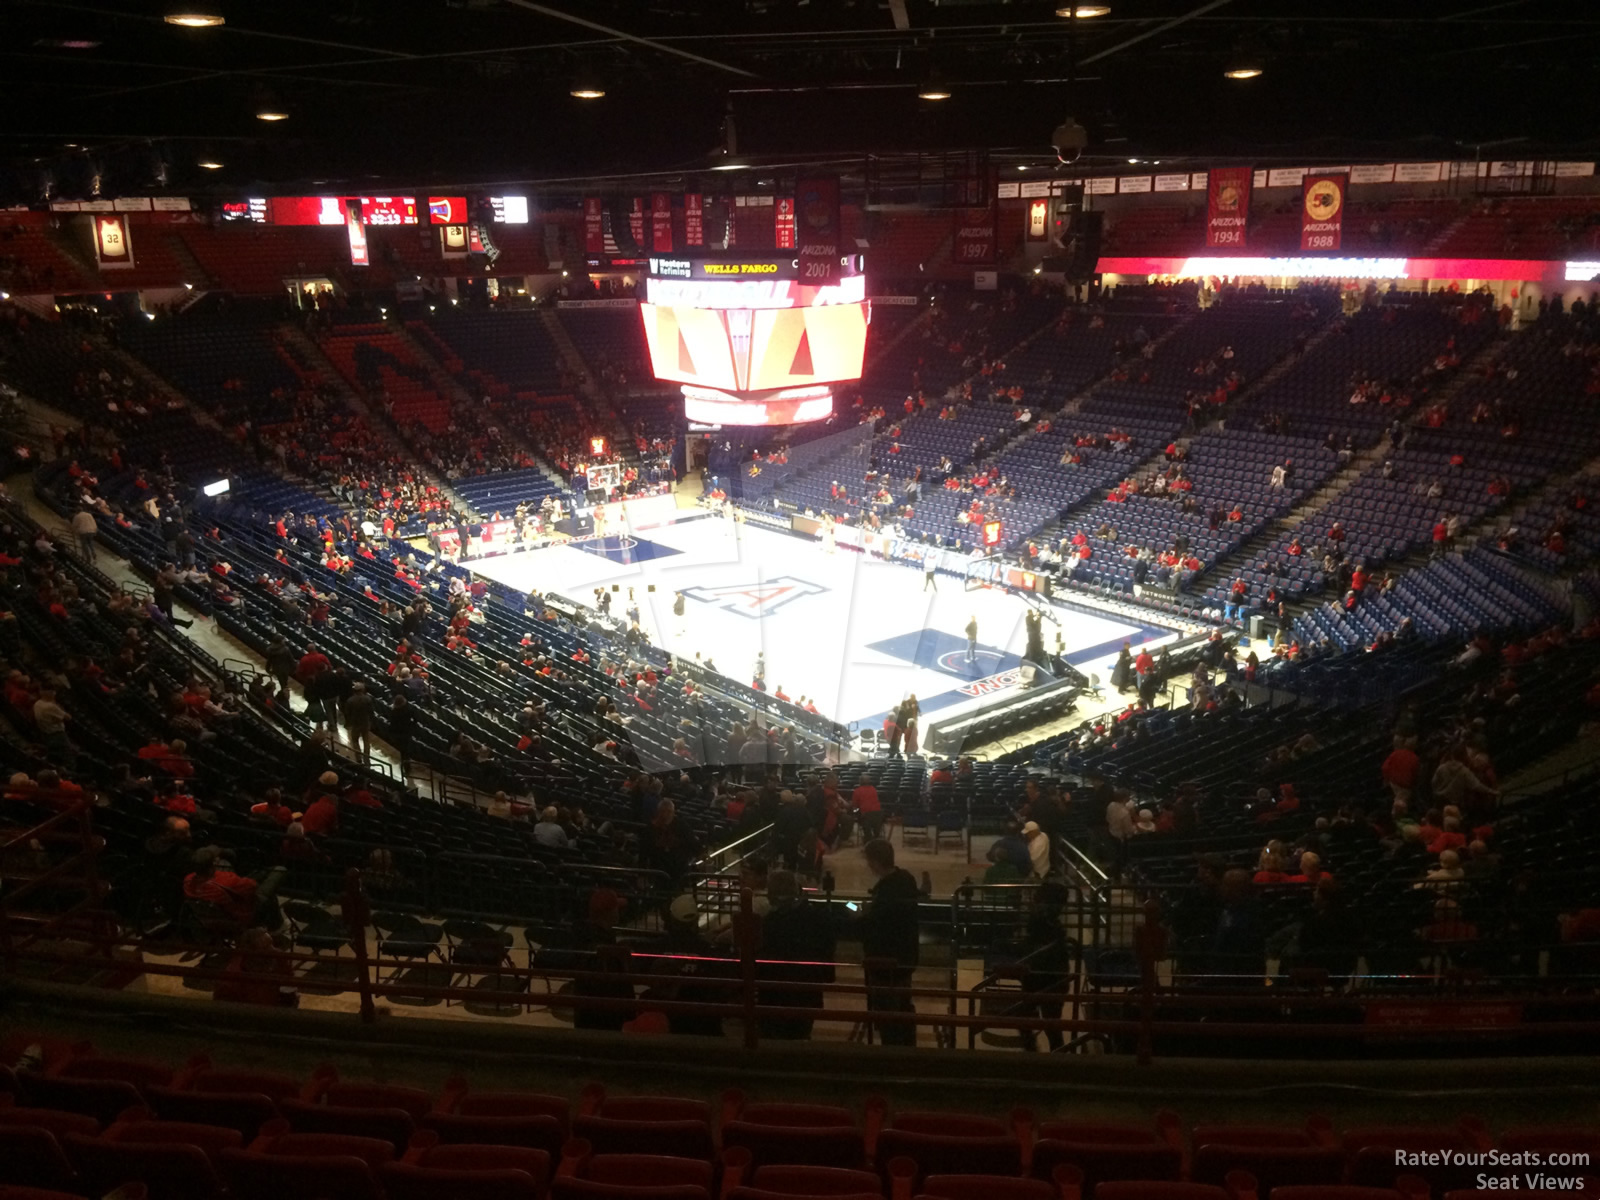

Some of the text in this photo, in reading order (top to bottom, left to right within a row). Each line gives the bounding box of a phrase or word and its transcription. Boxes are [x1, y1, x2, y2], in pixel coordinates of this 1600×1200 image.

[1208, 217, 1246, 227] ARIZONA
[1303, 222, 1341, 232] ARIZONA
[958, 227, 993, 238] ARIZONA
[1213, 231, 1240, 243] 1994
[107, 234, 119, 244] 32
[1307, 236, 1334, 247] 1988
[801, 245, 837, 256] ARIZONA
[962, 244, 988, 258] 1997
[659, 259, 691, 268] Western
[703, 264, 778, 274] WELLS FARGO
[659, 267, 691, 278] Refining
[805, 263, 831, 278] 2001
[1141, 590, 1176, 601] NETWORKS
